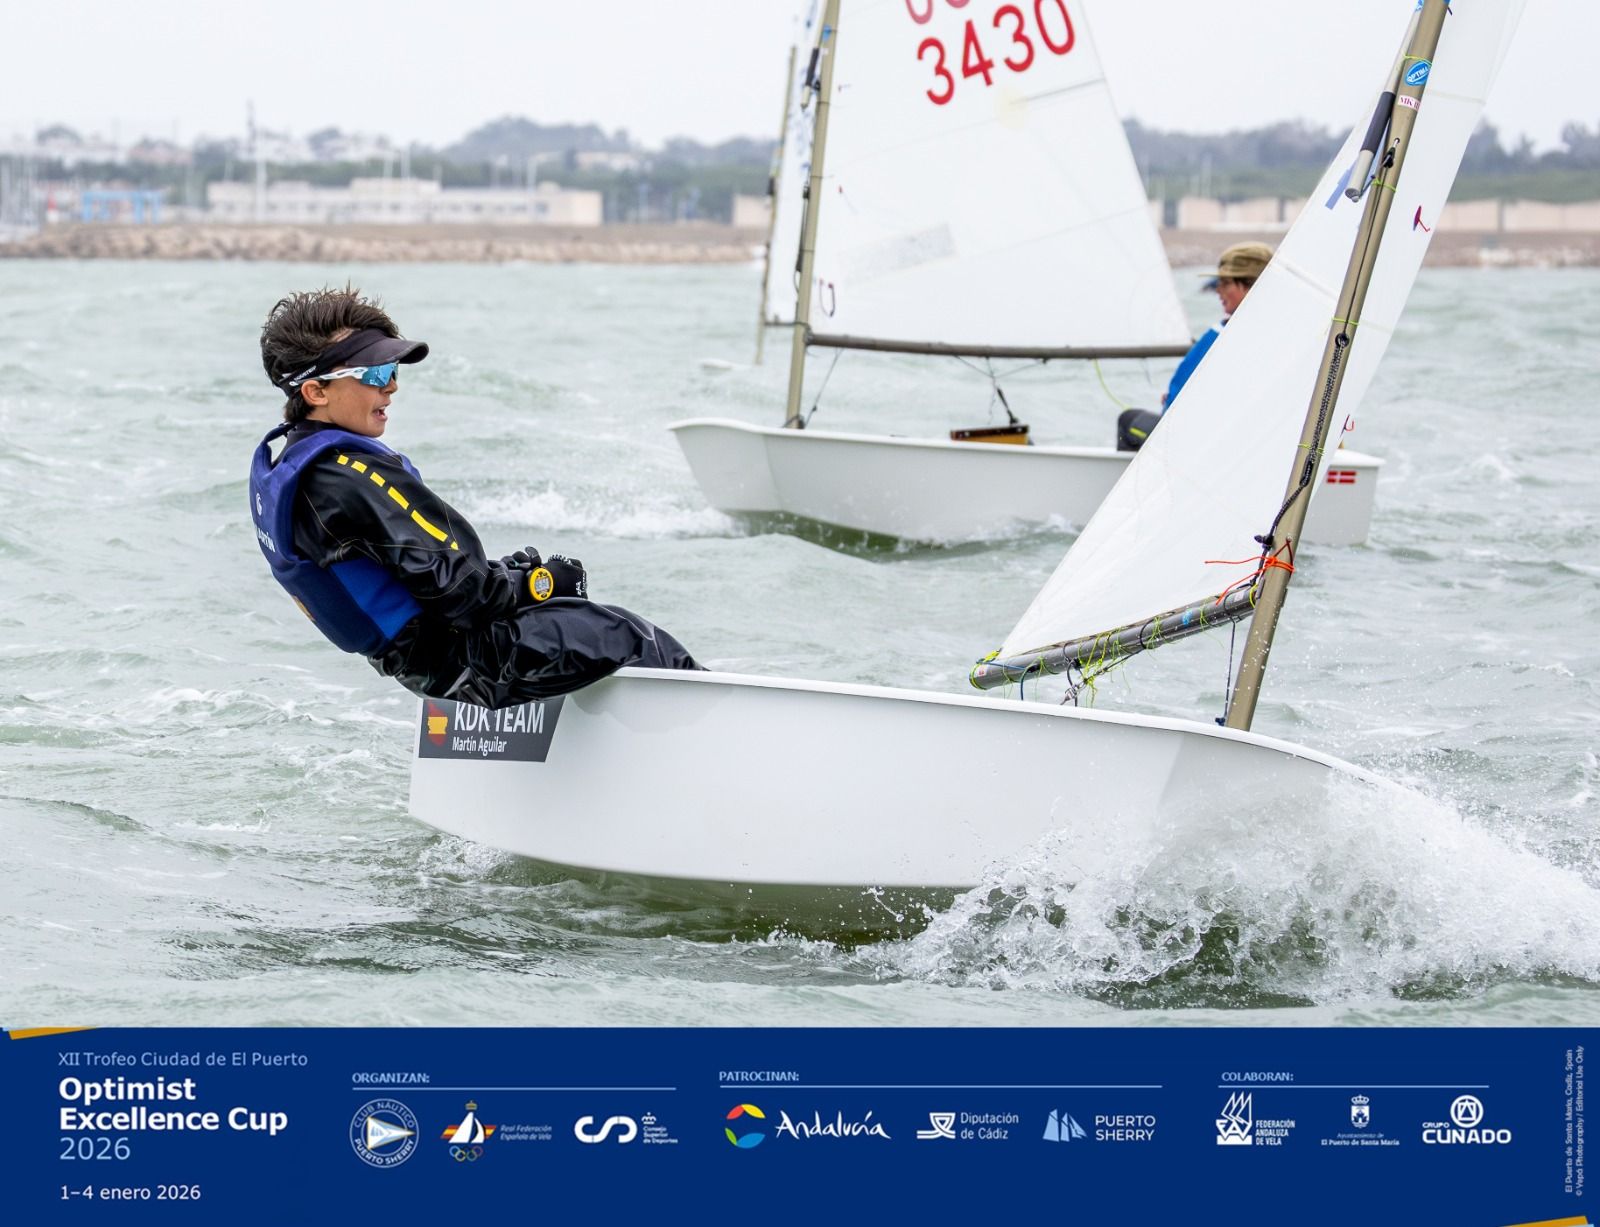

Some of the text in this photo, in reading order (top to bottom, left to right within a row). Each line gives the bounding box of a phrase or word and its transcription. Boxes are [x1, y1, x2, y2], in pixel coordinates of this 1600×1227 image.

[917, 0, 1075, 105] 3430
[453, 702, 545, 734] KDK TEAM
[452, 736, 507, 756] Martín Aguilar
